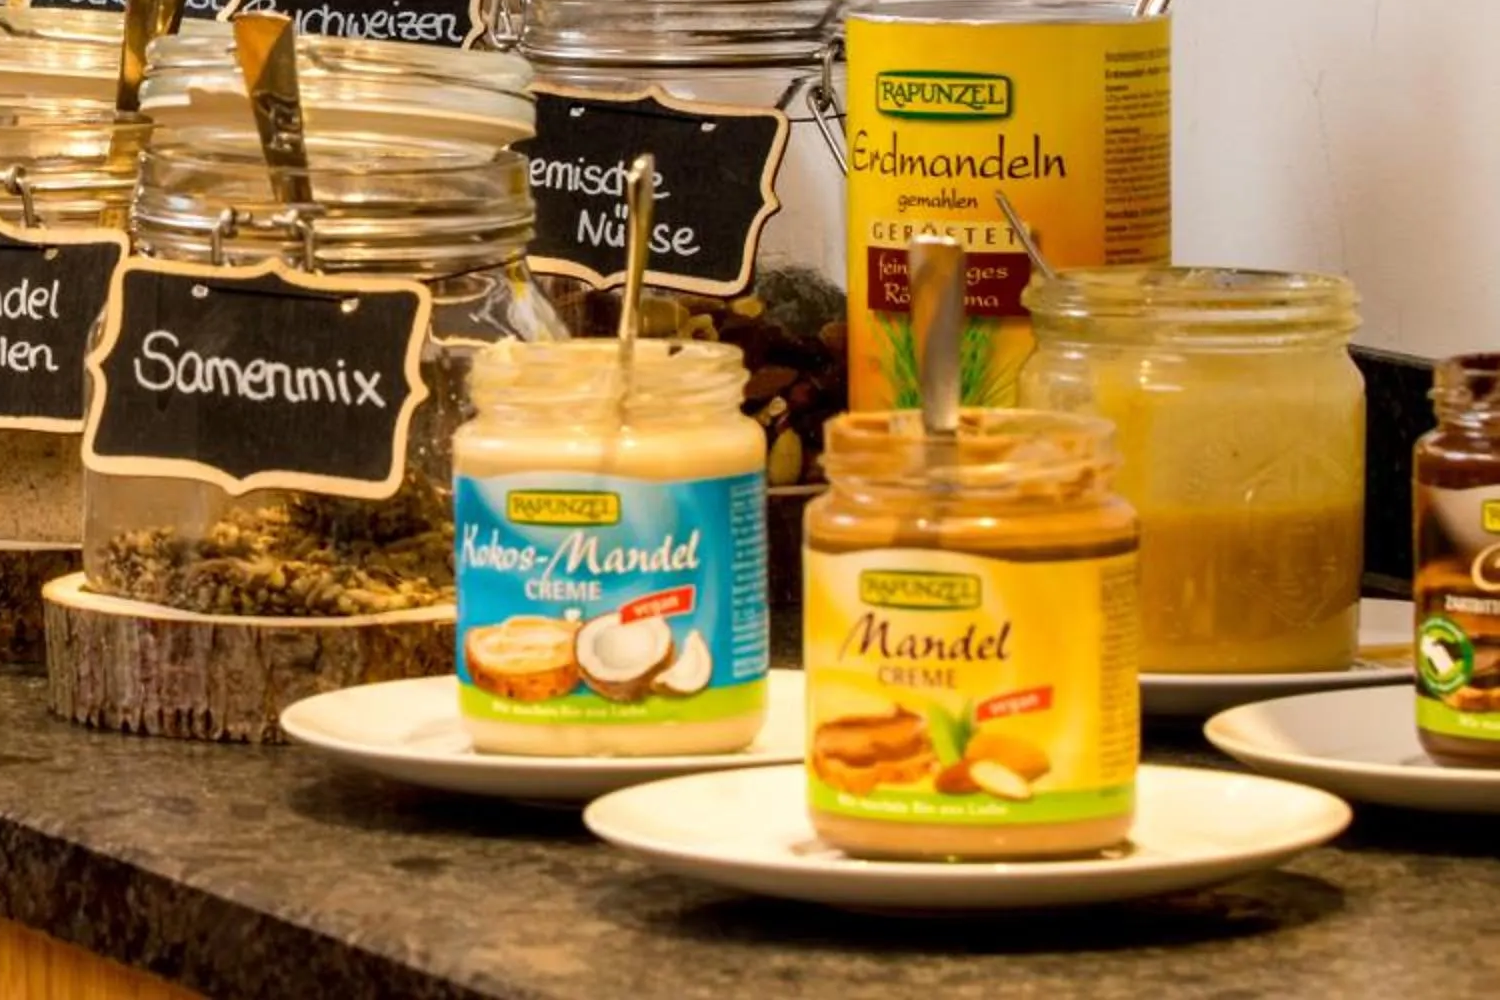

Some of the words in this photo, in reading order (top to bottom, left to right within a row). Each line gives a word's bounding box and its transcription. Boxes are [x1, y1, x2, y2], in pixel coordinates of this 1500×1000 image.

[882, 80, 1003, 111] RAPUNZEL
[852, 129, 1067, 180] Erdmandeln
[897, 188, 979, 213] gemahlen
[577, 203, 700, 256] Nüse
[134, 330, 387, 407] Samenmix
[461, 521, 700, 580] Kokos-Mandel
[525, 578, 602, 600] CREME
[839, 613, 1012, 662] Mandel
[878, 666, 957, 689] CREME
